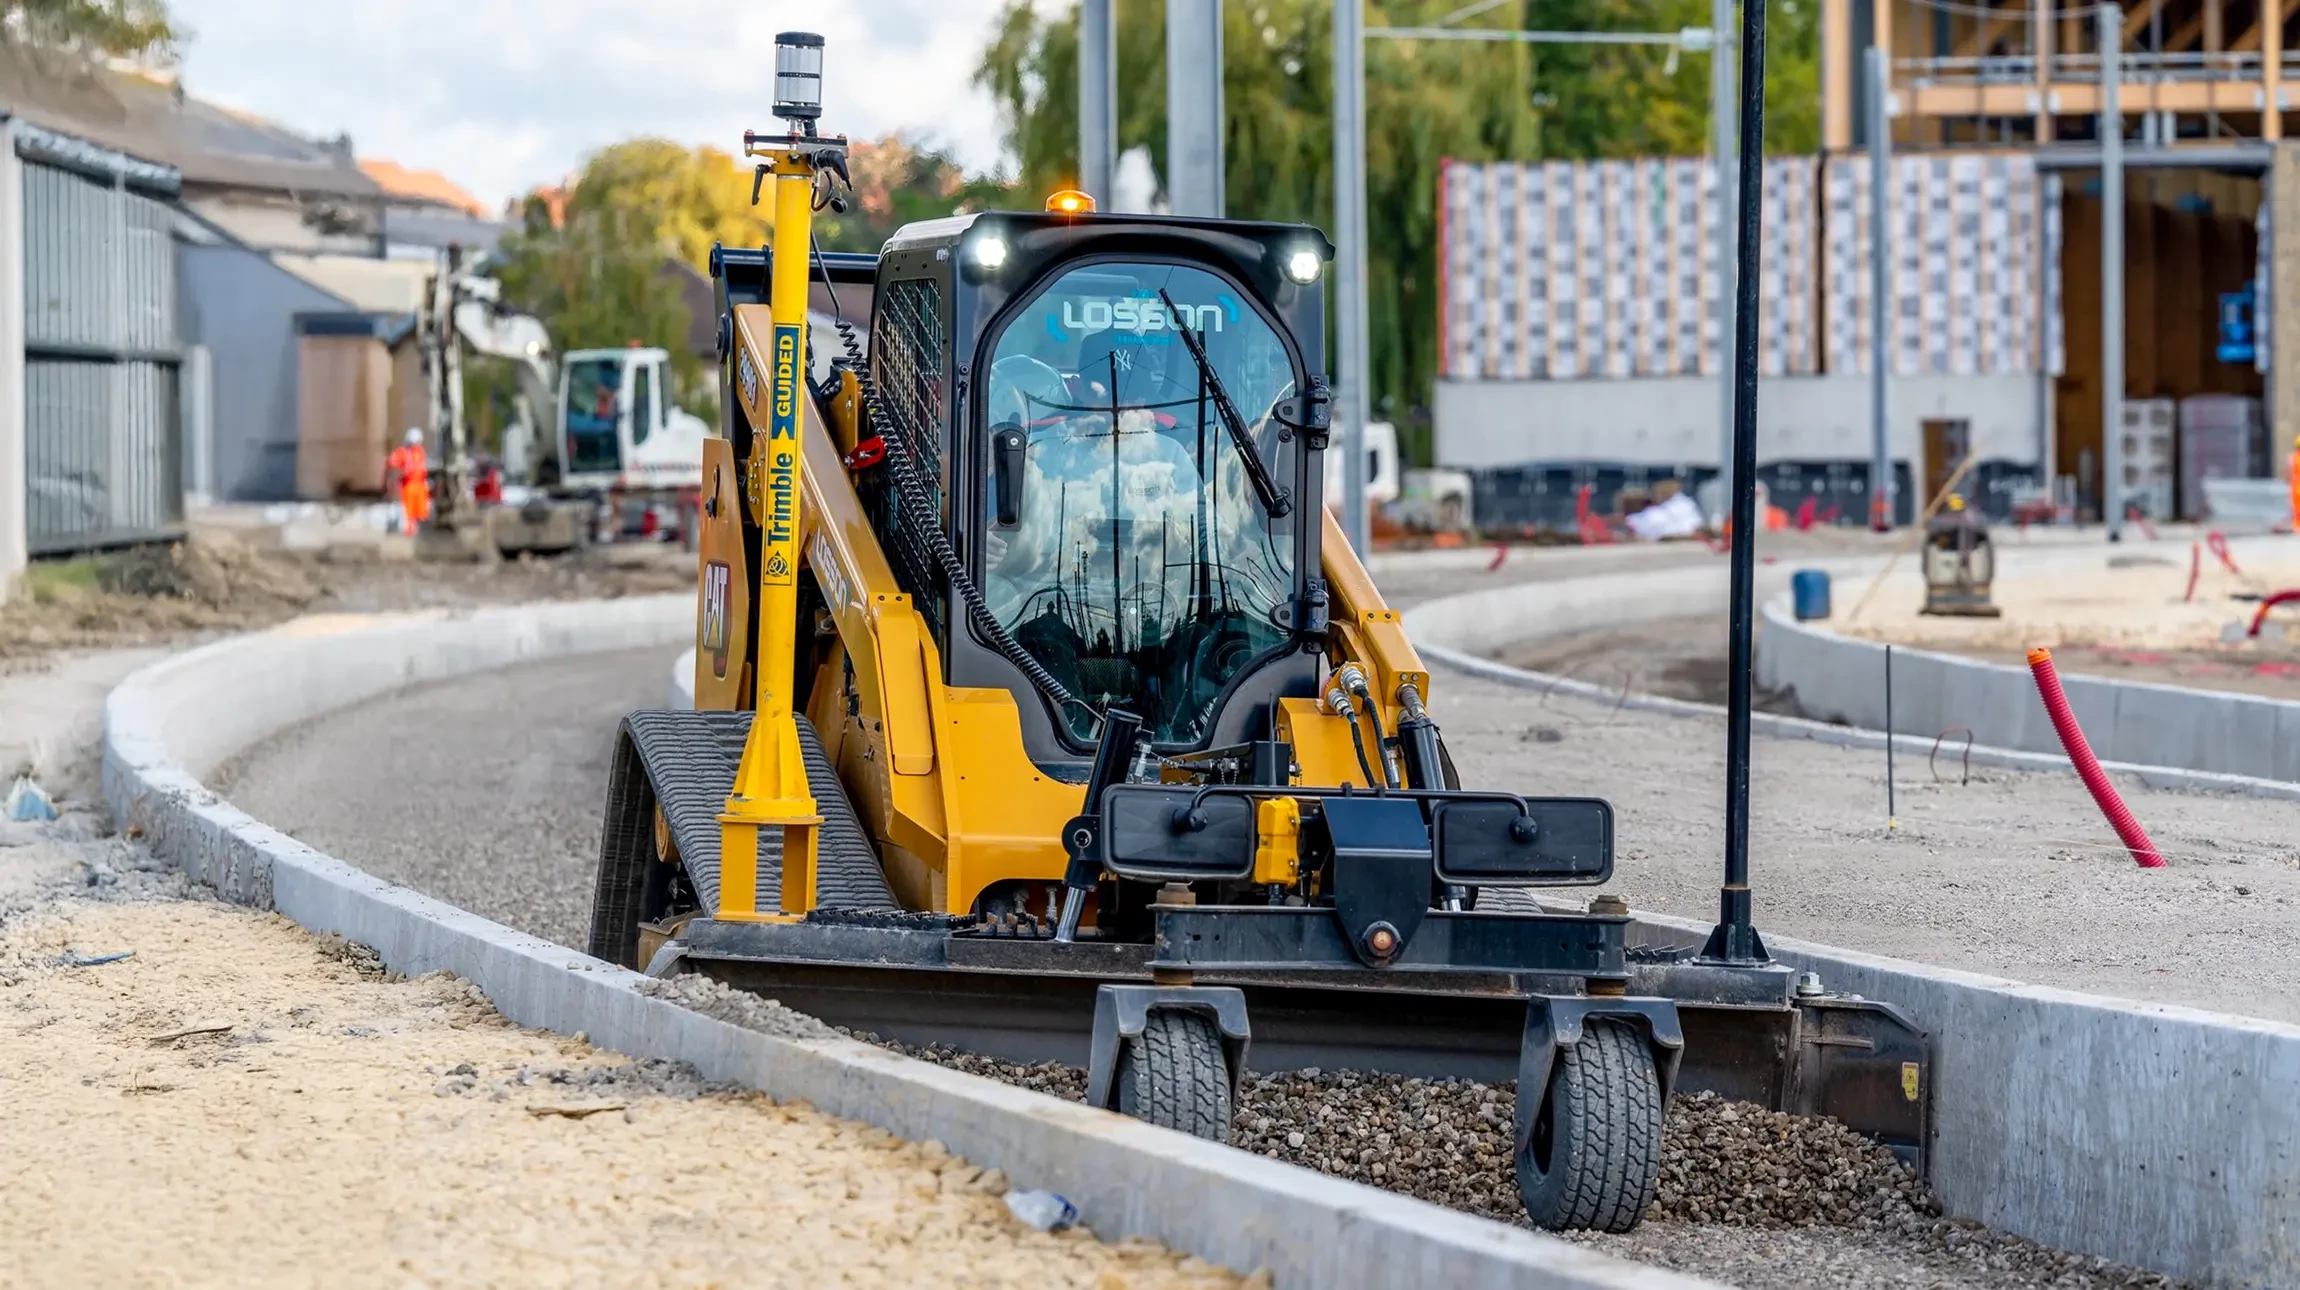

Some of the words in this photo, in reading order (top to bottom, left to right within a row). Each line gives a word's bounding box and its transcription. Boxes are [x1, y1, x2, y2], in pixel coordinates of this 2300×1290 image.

[776, 335, 794, 417] GUIDED
[767, 452, 793, 547] Trimble
[703, 563, 728, 649] CAT
